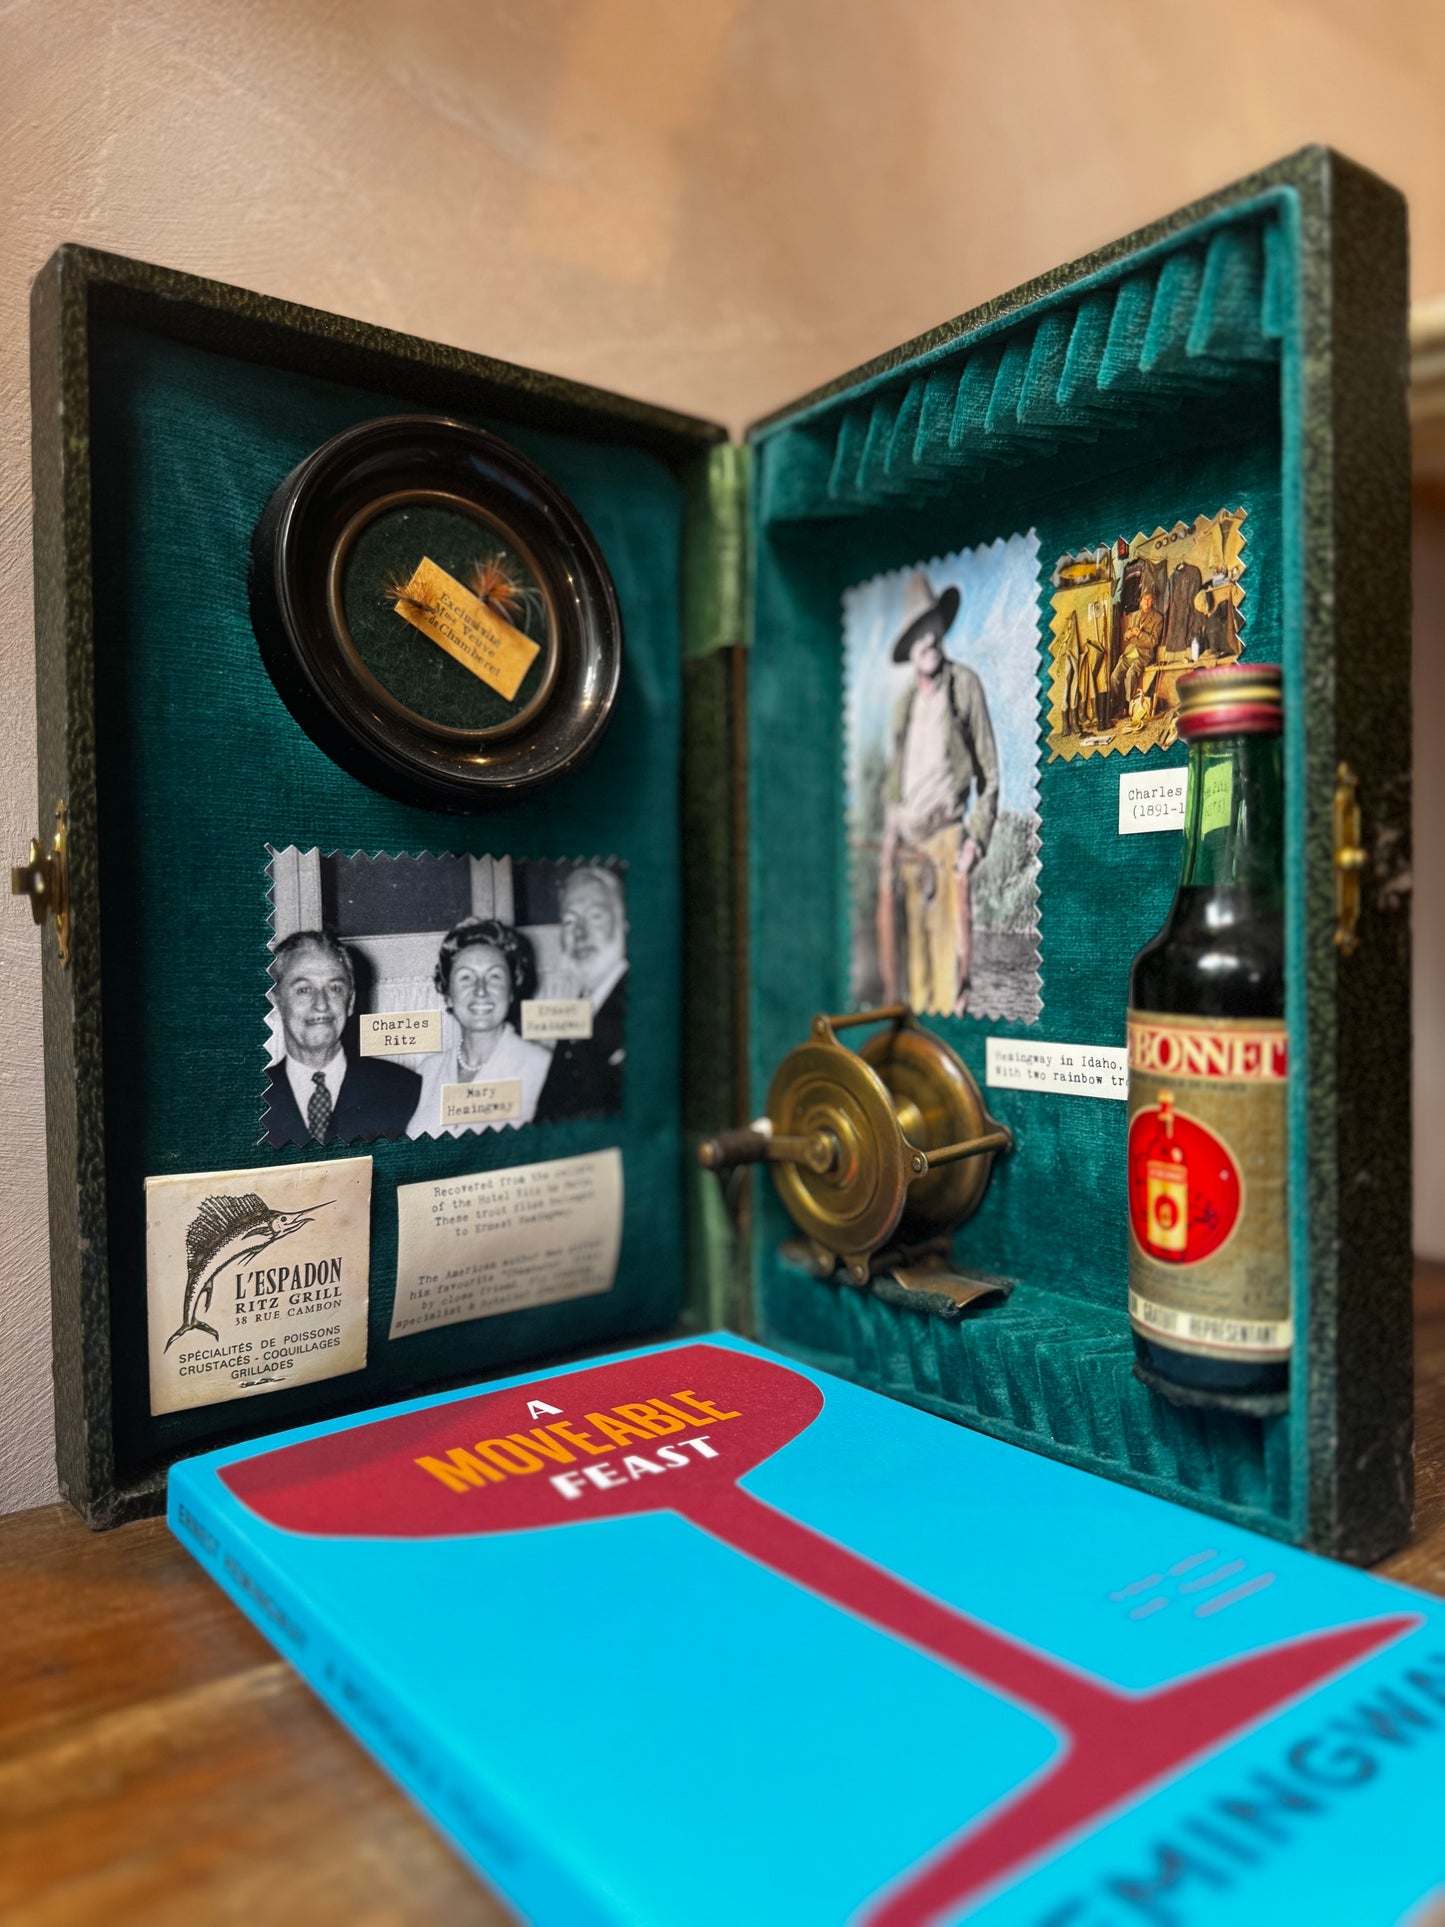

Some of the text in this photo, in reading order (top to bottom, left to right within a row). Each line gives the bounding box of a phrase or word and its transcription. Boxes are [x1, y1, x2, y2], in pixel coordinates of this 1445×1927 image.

[462, 624, 495, 657] Veuve
[1128, 786, 1182, 801] Charles
[372, 1019, 429, 1032] Charles
[384, 1035, 417, 1046] Ritz
[995, 1051, 1123, 1070] Hemingway in Idaho,
[1129, 1029, 1285, 1077] BONNET
[995, 1066, 1021, 1078] With
[1027, 1069, 1046, 1080] two
[1053, 1072, 1103, 1085] rainbow
[467, 1087, 496, 1100] Mary
[447, 1101, 514, 1117] Hemingway
[434, 1182, 494, 1197] Recovered
[432, 1201, 445, 1213] of
[452, 1198, 472, 1209] the
[478, 1191, 510, 1206] Hotel
[434, 1214, 470, 1227] These
[476, 1206, 507, 1219] trout
[455, 1226, 468, 1237] to
[235, 1257, 343, 1300] L'ESPADON
[418, 1275, 438, 1286] The
[235, 1286, 343, 1314] RITZ GRILL
[421, 1300, 434, 1311] by
[235, 1300, 342, 1326] 38 RUE CAMBON
[179, 1325, 341, 1364] SPÉCIALITÉS DE POISSONS
[179, 1355, 251, 1376] CRUSTACÉS
[263, 1337, 341, 1361] COQUILLAGES
[231, 1359, 294, 1379] GRILLADES
[526, 1399, 564, 1419] A
[413, 1389, 743, 1494] MOVEABLE
[549, 1435, 720, 1501] FEAST
